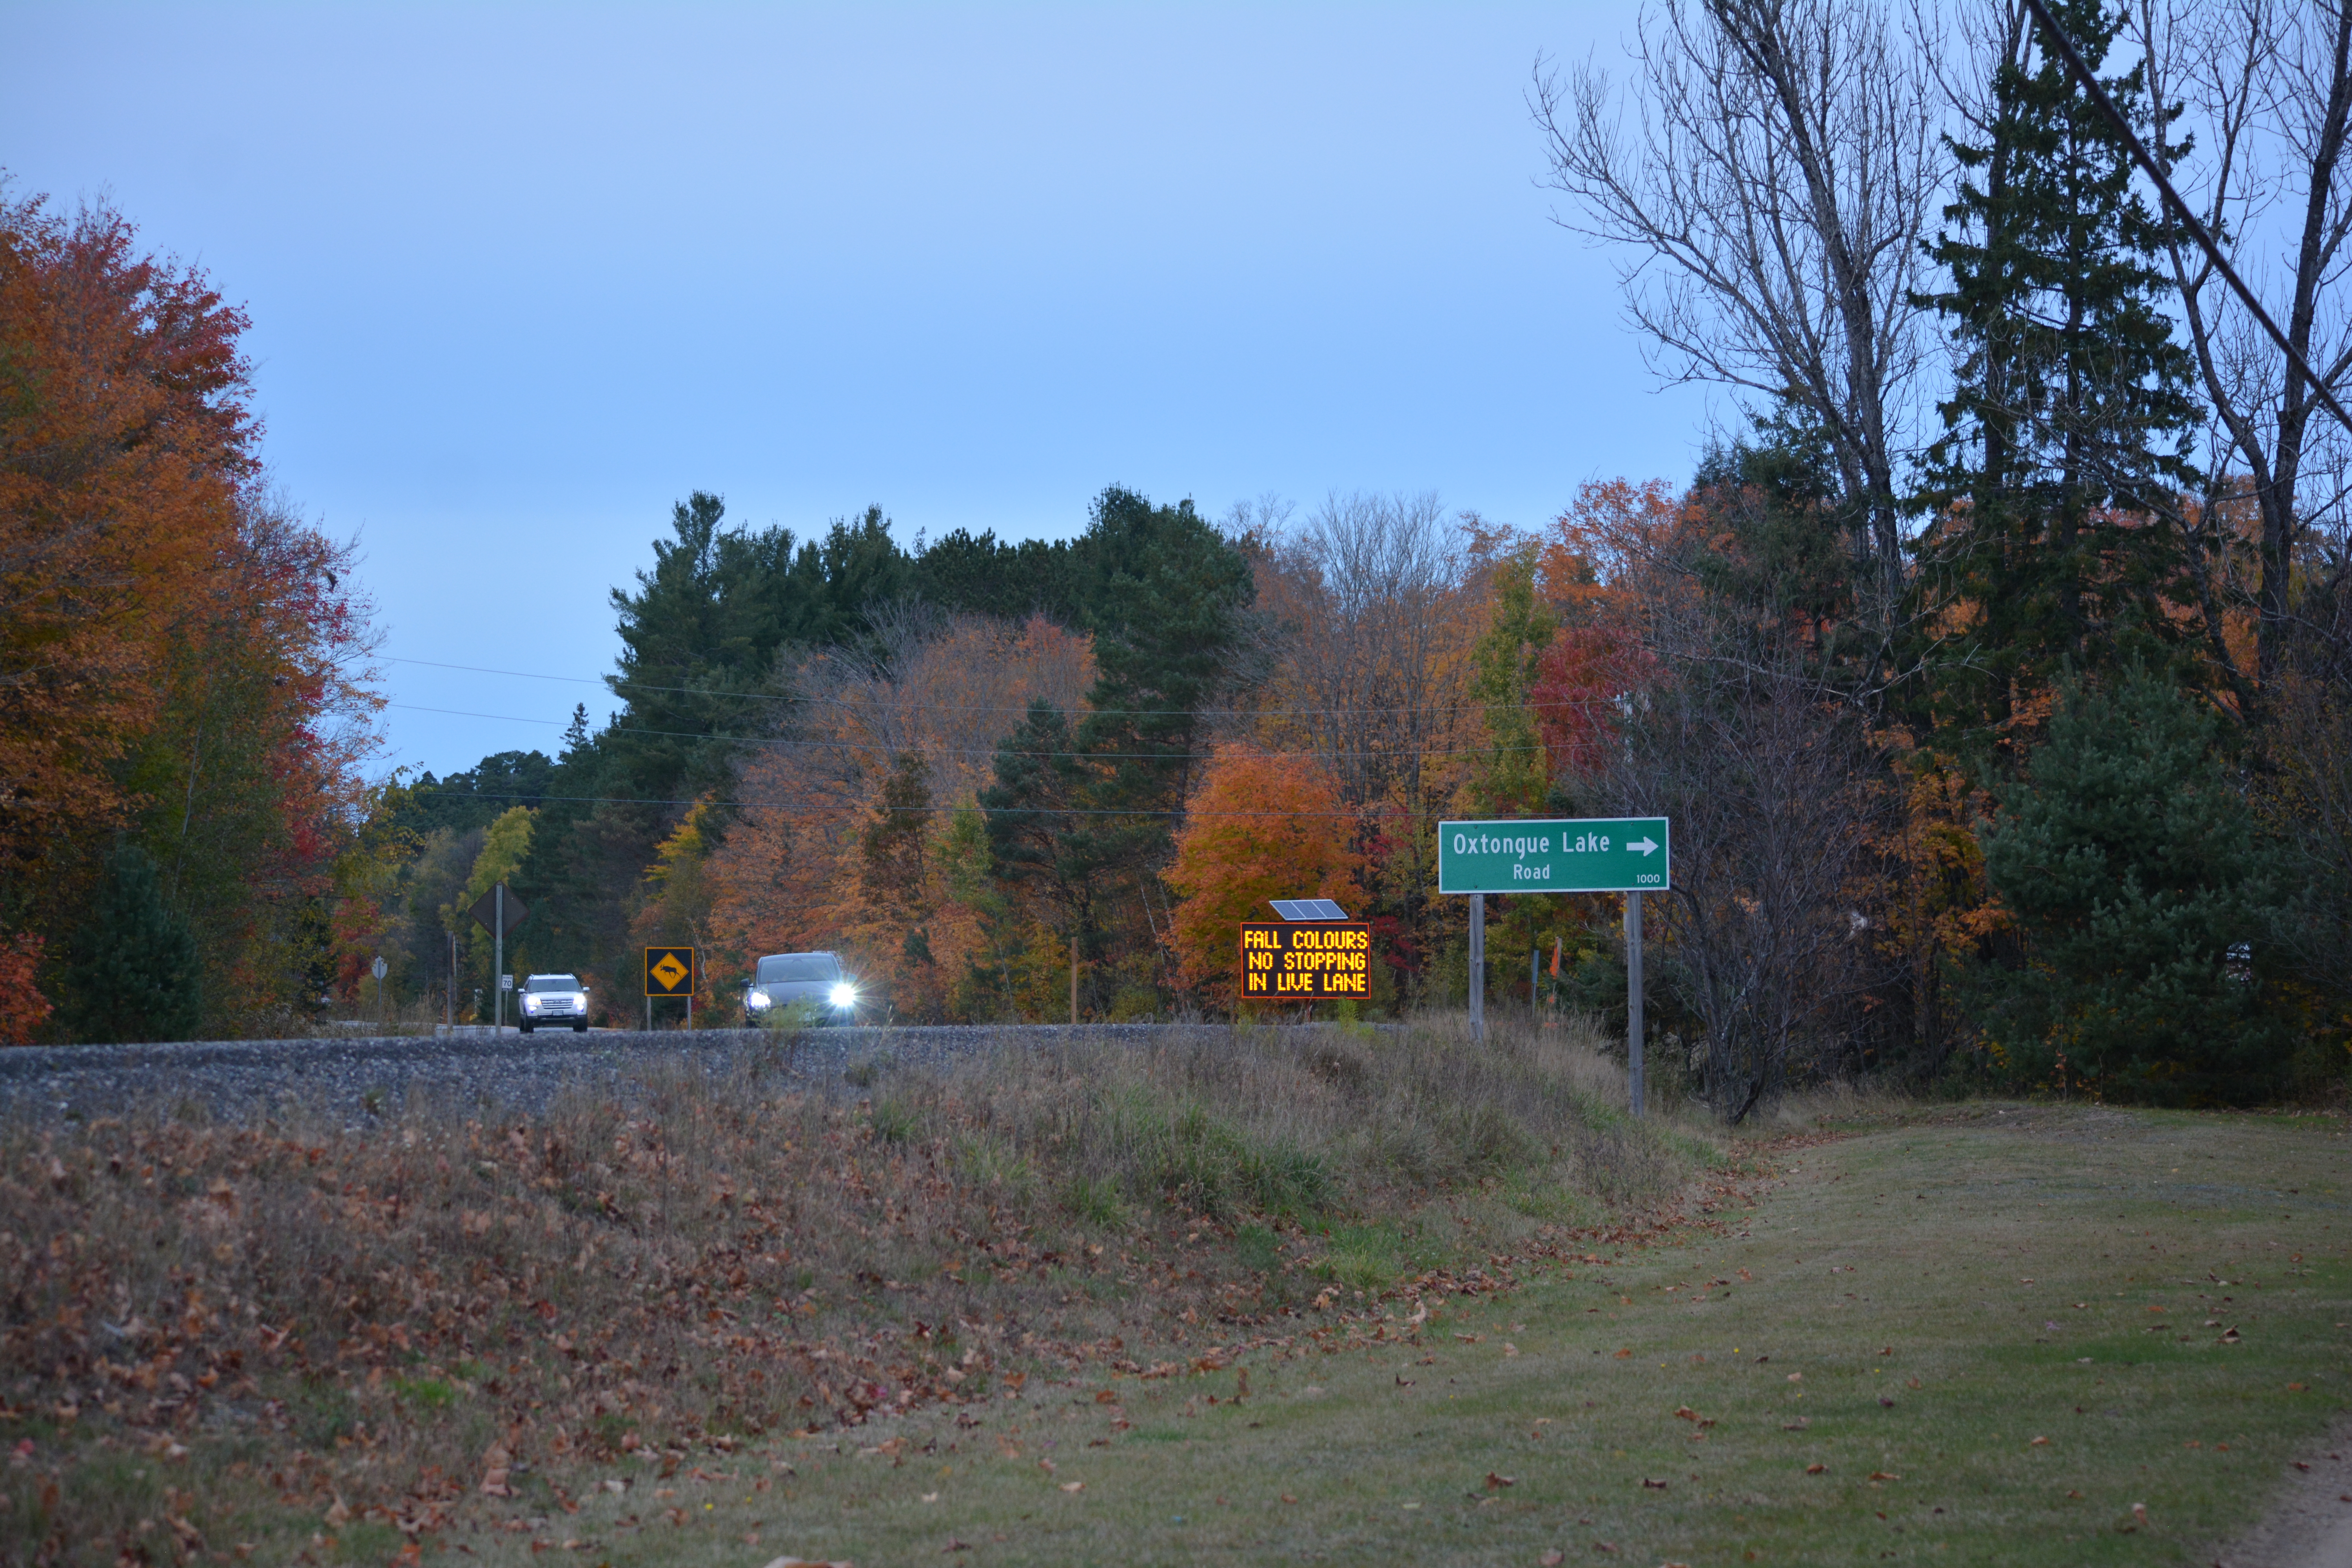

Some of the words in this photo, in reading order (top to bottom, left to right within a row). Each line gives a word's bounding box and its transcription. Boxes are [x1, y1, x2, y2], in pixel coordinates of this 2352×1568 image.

[1454, 833, 1549, 860] Oxtongue
[1563, 832, 1610, 852] Lake
[1514, 864, 1550, 880] Road
[1637, 874, 1660, 883] 1000
[1245, 931, 1281, 949] FALL
[1293, 931, 1368, 949] COLOURS
[1249, 952, 1273, 969] NO
[1284, 952, 1366, 970] STOPPING
[1249, 973, 1267, 991] IN
[1278, 973, 1313, 991] LIVE
[1323, 973, 1366, 991] LANE
